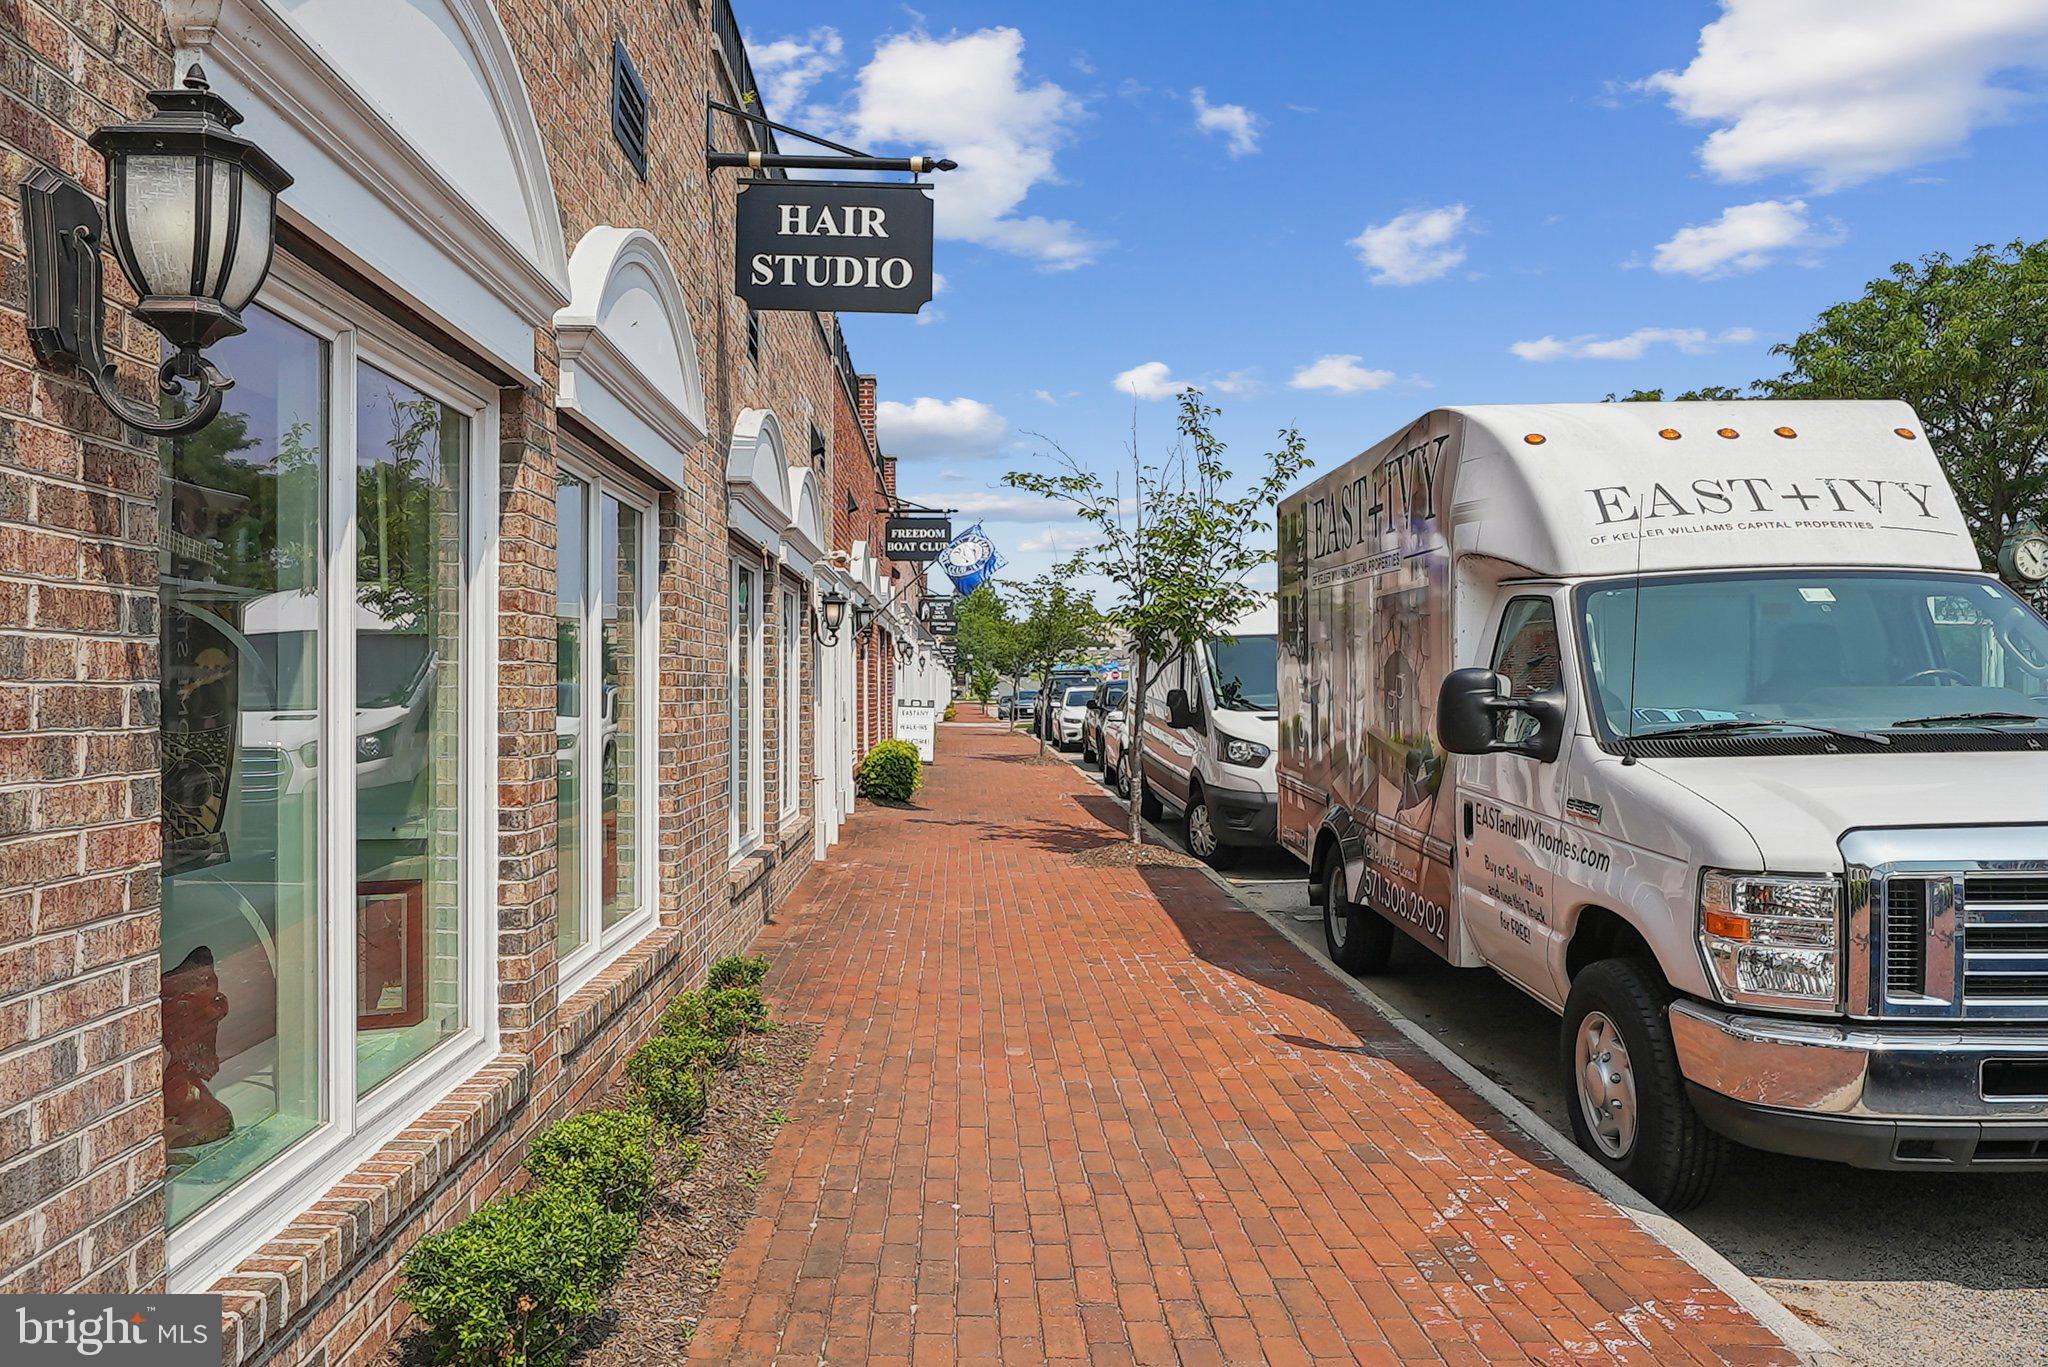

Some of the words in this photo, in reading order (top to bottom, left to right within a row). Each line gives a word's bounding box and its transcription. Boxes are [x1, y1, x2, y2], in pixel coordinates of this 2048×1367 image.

[777, 204, 889, 238] HAIR
[751, 253, 913, 289] STUDIO
[1313, 434, 1449, 560] EAST+IVY
[1585, 477, 1939, 525] EAST+IVY
[887, 542, 916, 552] BOAT
[891, 528, 946, 539] FREEDOM
[1590, 536, 1606, 545] OF
[1613, 528, 1664, 542] KELLER
[1668, 523, 1733, 535] WILLIAMS
[1737, 520, 1792, 530] CAPITAL
[1795, 520, 1874, 530] PROPERTIES
[1476, 803, 1611, 873] EASTandIVYhomes.com
[1484, 854, 1497, 878] Buy
[1498, 865, 1505, 878] or
[1506, 864, 1518, 885] Sell
[1519, 873, 1534, 893] with
[1535, 884, 1544, 898] us
[1363, 866, 1445, 941] 571.308.2902
